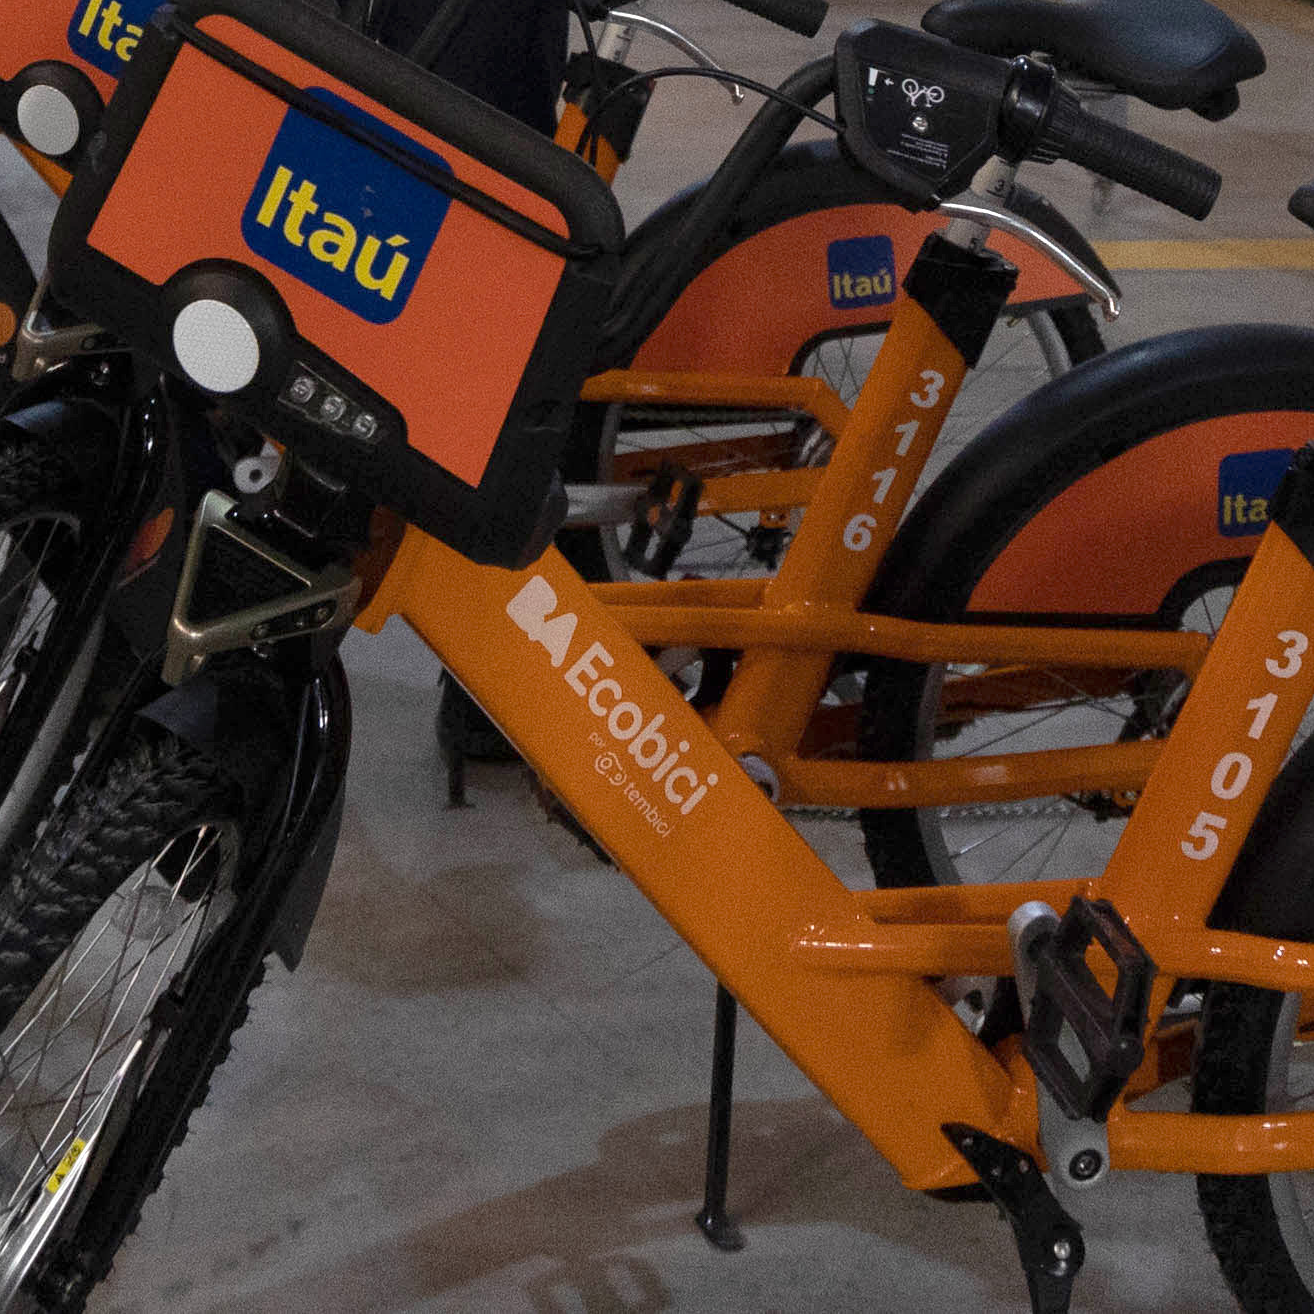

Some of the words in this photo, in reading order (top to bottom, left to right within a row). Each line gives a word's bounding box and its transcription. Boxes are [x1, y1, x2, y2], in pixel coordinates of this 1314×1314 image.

[256, 165, 409, 301] Itaú
[833, 268, 893, 300] Itaú
[843, 369, 945, 551] 3116
[1224, 494, 1269, 525] Ita
[564, 641, 719, 815] Ecobici
[1181, 630, 1309, 861] 3105
[624, 781, 675, 838] tembici
